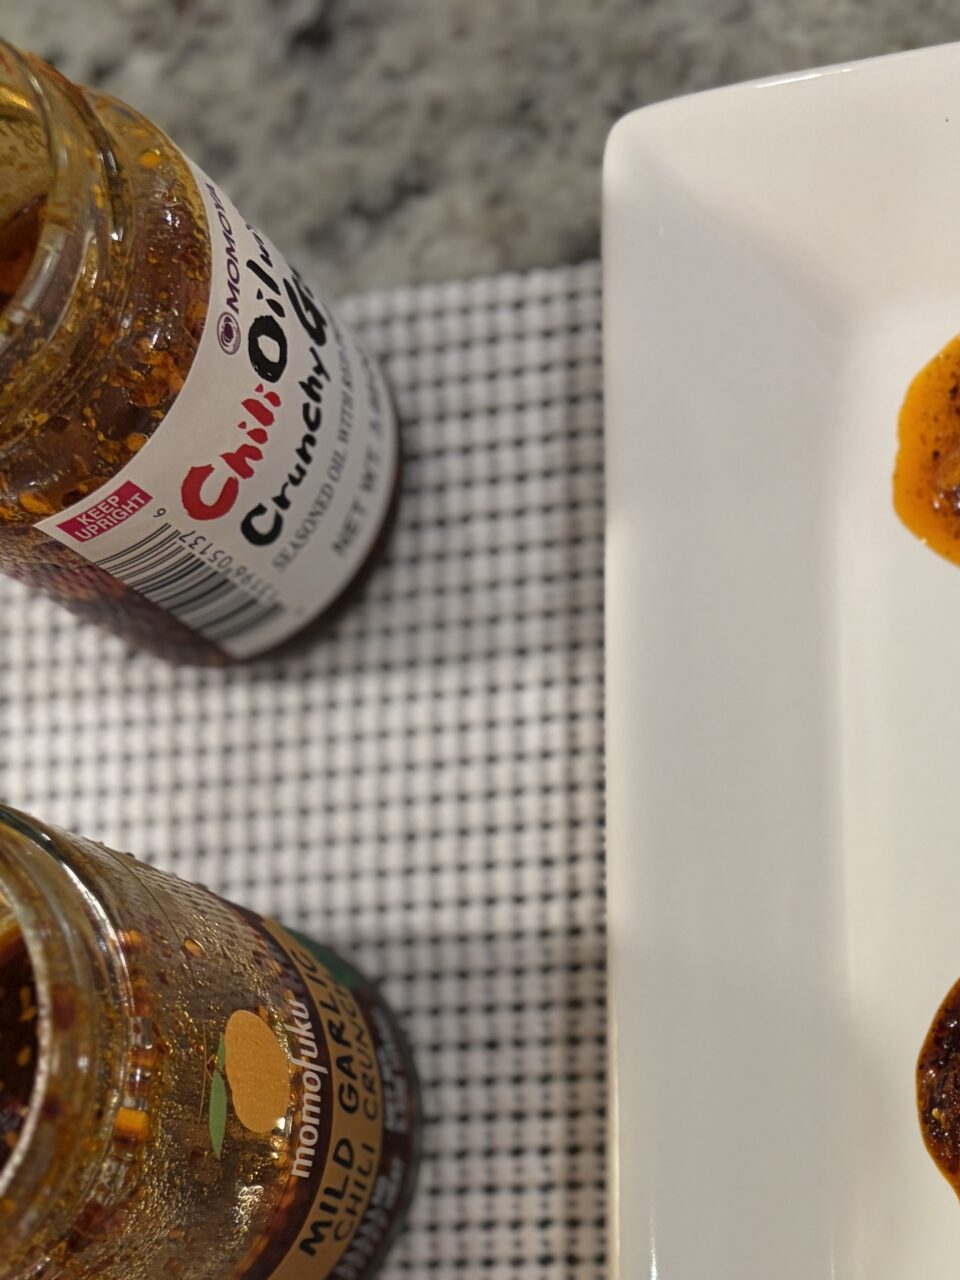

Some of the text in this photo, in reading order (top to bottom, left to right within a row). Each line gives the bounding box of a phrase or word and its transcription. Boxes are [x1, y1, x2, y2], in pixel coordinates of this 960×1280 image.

[206, 183, 240, 315] MOMOYA
[181, 383, 281, 521] Chili
[247, 259, 288, 384] Oil
[240, 346, 331, 546] Crunchy
[75, 492, 146, 540] UPRIGHT
[76, 495, 120, 525] KEEP
[283, 1000, 329, 1179] momofuku
[289, 947, 360, 1258] MILD GARLIC
[333, 1143, 376, 1244] CHILI
